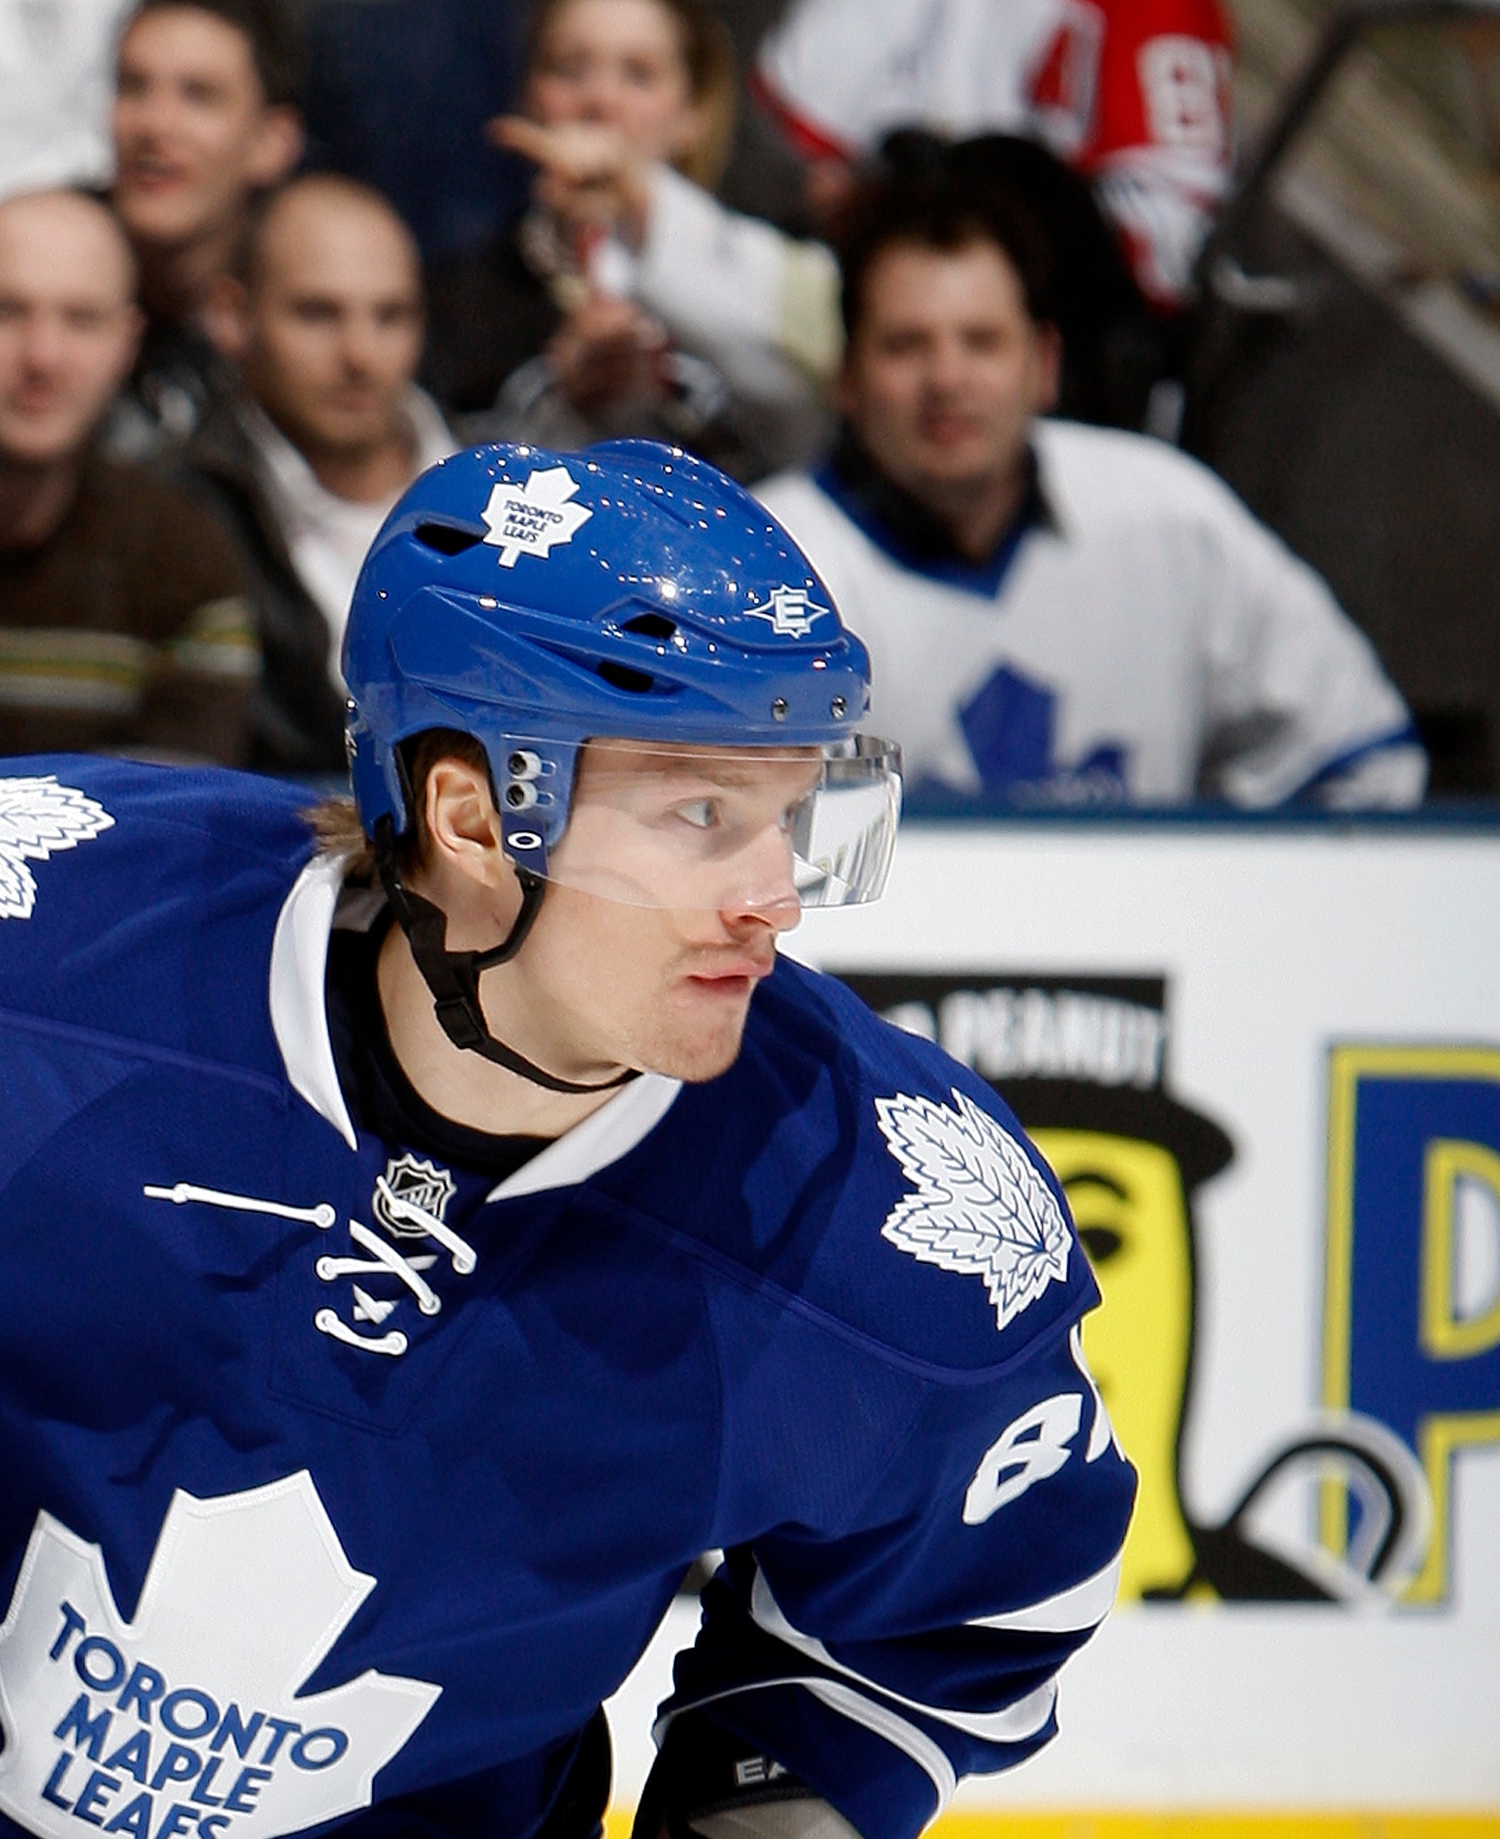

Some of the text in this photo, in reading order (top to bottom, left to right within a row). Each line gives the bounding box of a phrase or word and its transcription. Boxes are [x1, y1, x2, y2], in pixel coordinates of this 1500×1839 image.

[503, 525, 539, 542] LEAFS
[504, 500, 563, 524] TORONTO
[506, 513, 548, 532] MAPLE
[940, 987, 1164, 1092] PEANUT
[50, 1600, 350, 1771] TORONTO
[53, 1692, 273, 1814] MAPLE
